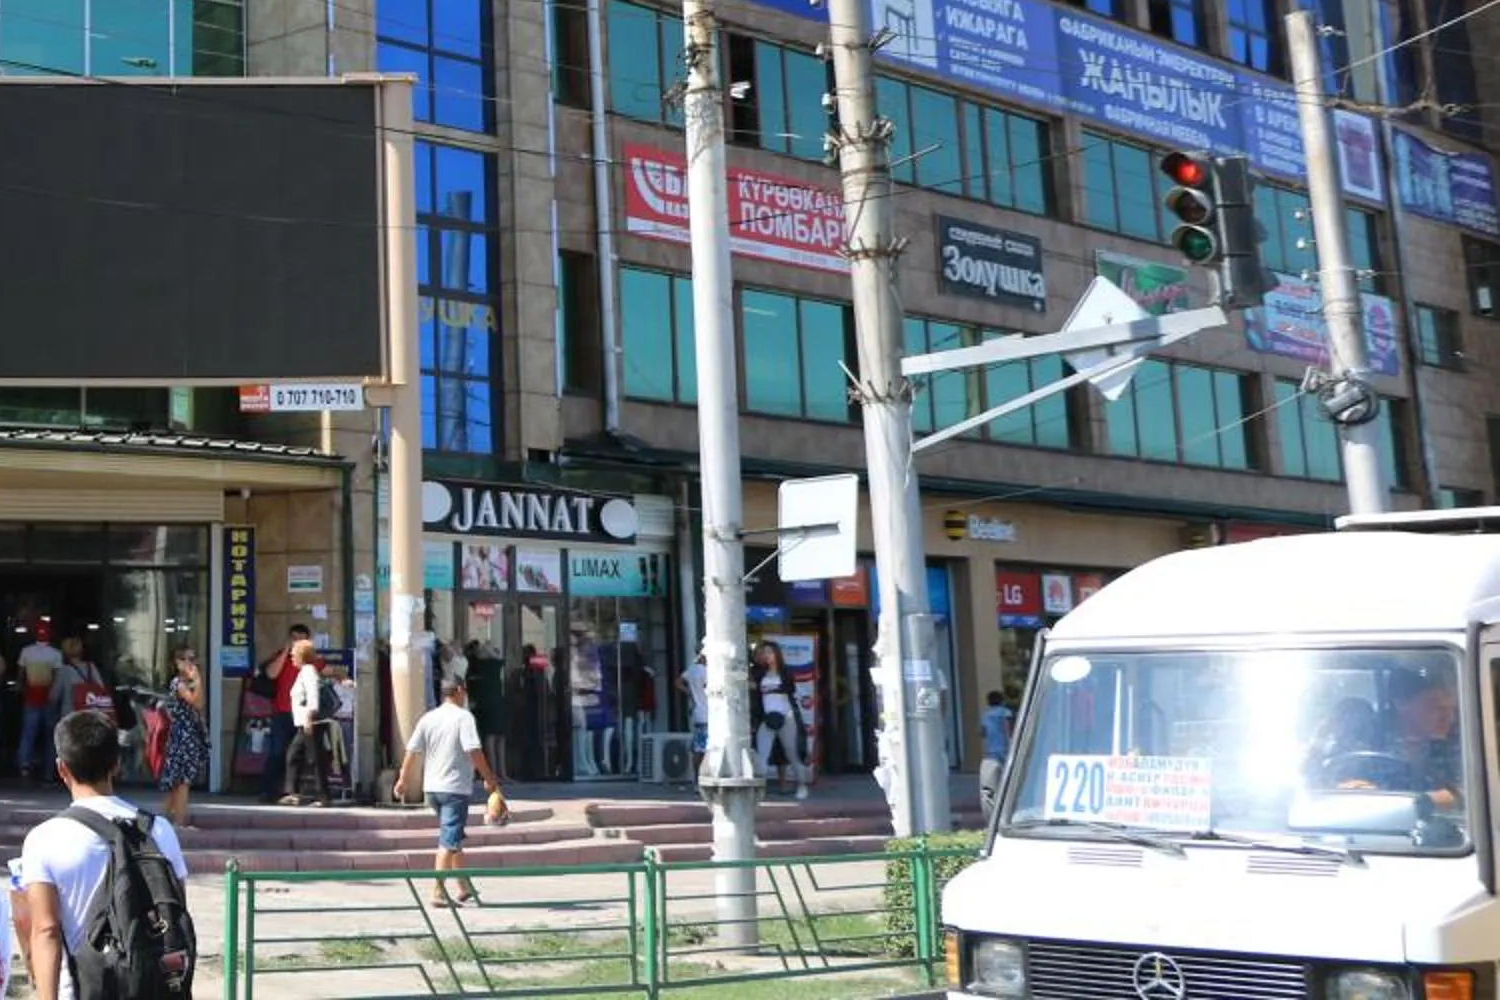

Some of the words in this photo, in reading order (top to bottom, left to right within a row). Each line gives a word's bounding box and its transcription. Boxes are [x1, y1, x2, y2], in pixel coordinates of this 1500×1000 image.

[945, 5, 1029, 50] ИЖАРАГА
[942, 245, 1046, 298] Золушка
[451, 487, 594, 533] JANNAT
[231, 530, 248, 646] НОТАРИУС
[572, 557, 621, 579] LIMAX
[1003, 584, 1024, 605] LG
[1053, 760, 1106, 814] 220
